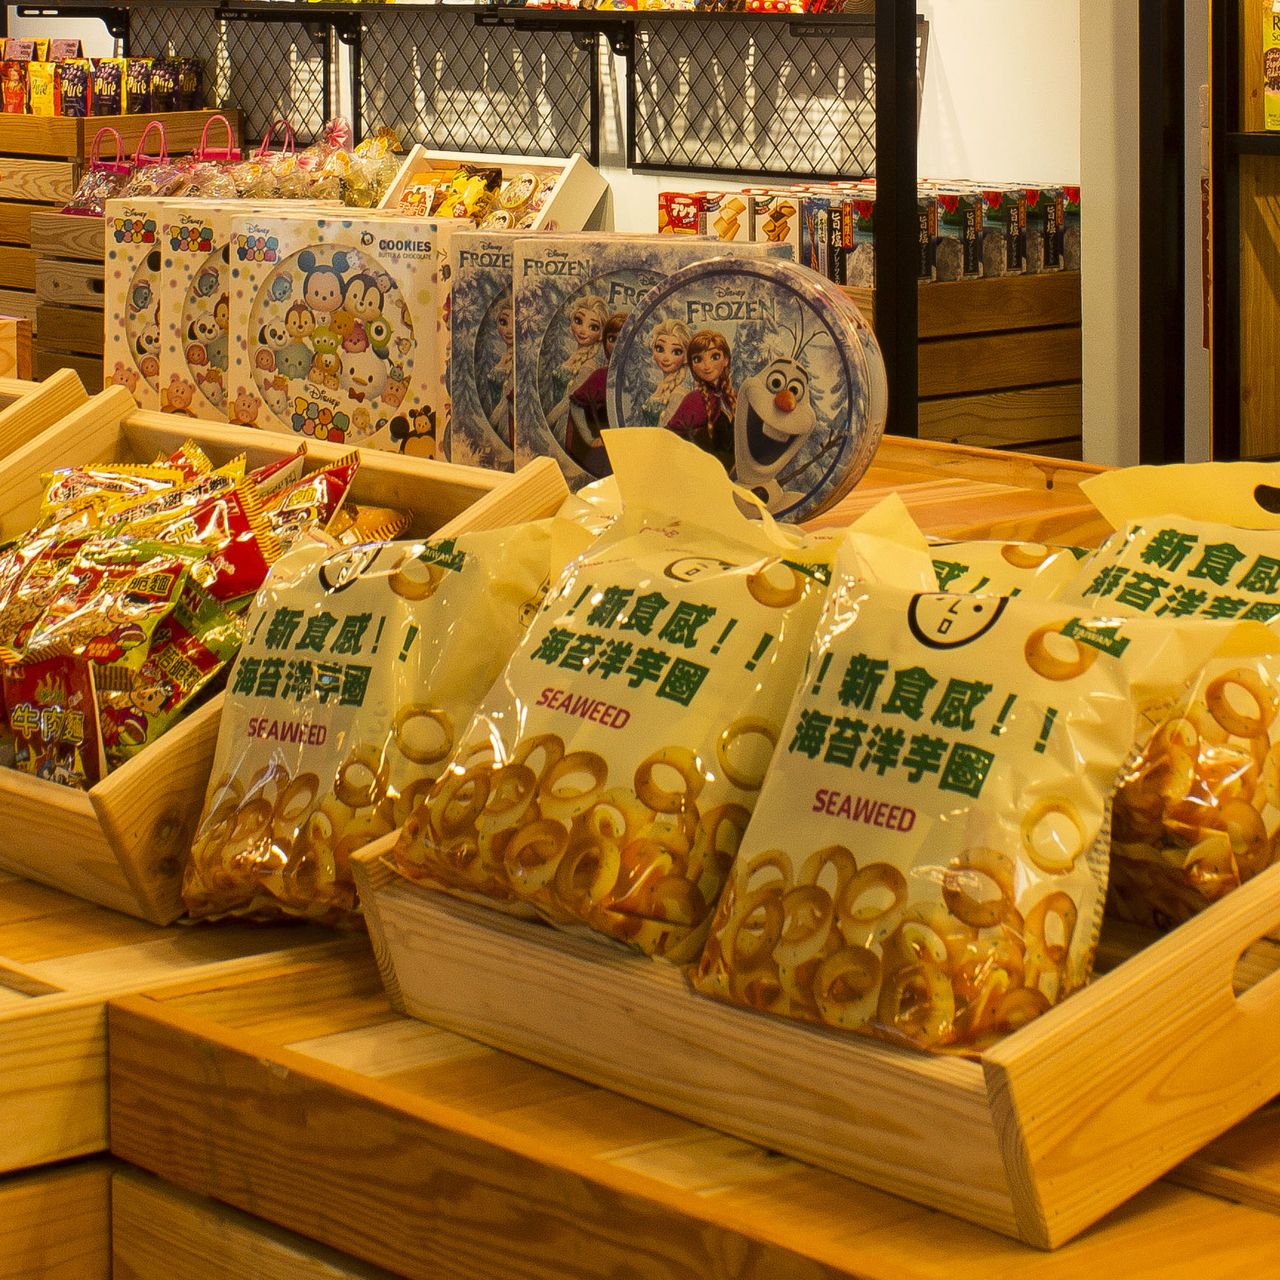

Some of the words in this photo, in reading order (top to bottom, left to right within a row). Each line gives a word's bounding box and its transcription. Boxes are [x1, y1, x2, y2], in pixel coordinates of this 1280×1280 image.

[378, 239, 432, 253] COOKIES
[459, 249, 514, 269] FROZE
[523, 257, 591, 277] FROZEN
[713, 285, 747, 300] Disney
[686, 296, 777, 325] FROZEN
[529, 626, 712, 707] 海苔洋芋圈
[535, 687, 631, 730] SEAWEED
[247, 717, 328, 746] SEAWEED
[788, 709, 996, 800] 海苔洋芋圈
[812, 789, 917, 833] SEAWEED
